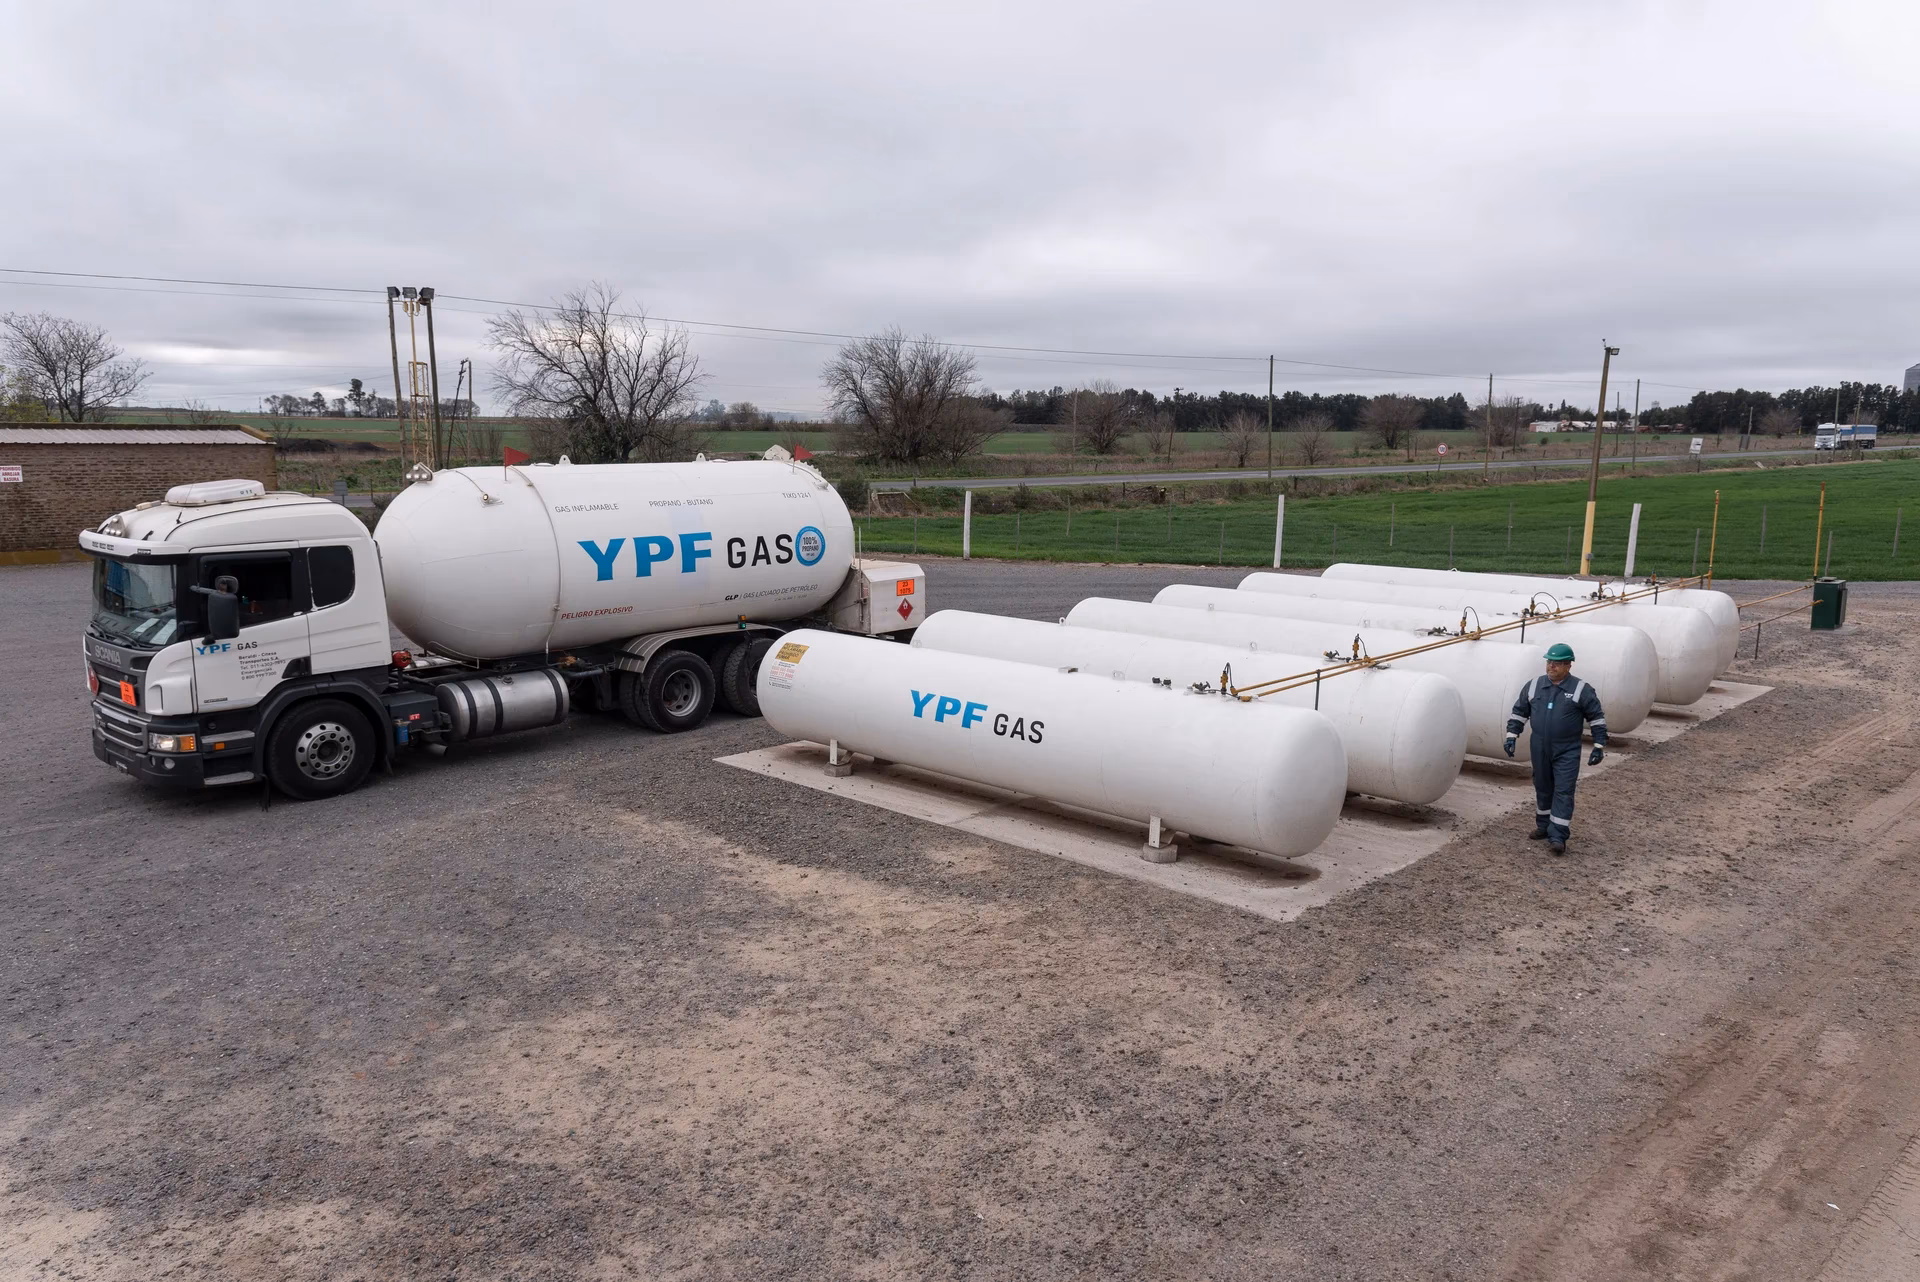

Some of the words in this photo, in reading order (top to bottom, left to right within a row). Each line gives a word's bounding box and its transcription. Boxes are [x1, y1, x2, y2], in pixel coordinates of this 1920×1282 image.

[555, 505, 571, 513] GAS
[572, 503, 619, 512] INFLAMABLE
[687, 498, 713, 506] BUTANO
[803, 536, 818, 546] 100%
[577, 532, 712, 581] YPF
[727, 534, 793, 568] GAS
[756, 588, 781, 597] LICUADO
[789, 584, 818, 593] PETRÓLEO
[561, 611, 593, 620] PELIGRO
[594, 606, 633, 616] EXPLOSIVO
[95, 645, 122, 665] SCANIA
[196, 643, 231, 655] YPF
[237, 642, 258, 651] GAS
[911, 690, 988, 729] YPF
[993, 713, 1045, 744] GAS
